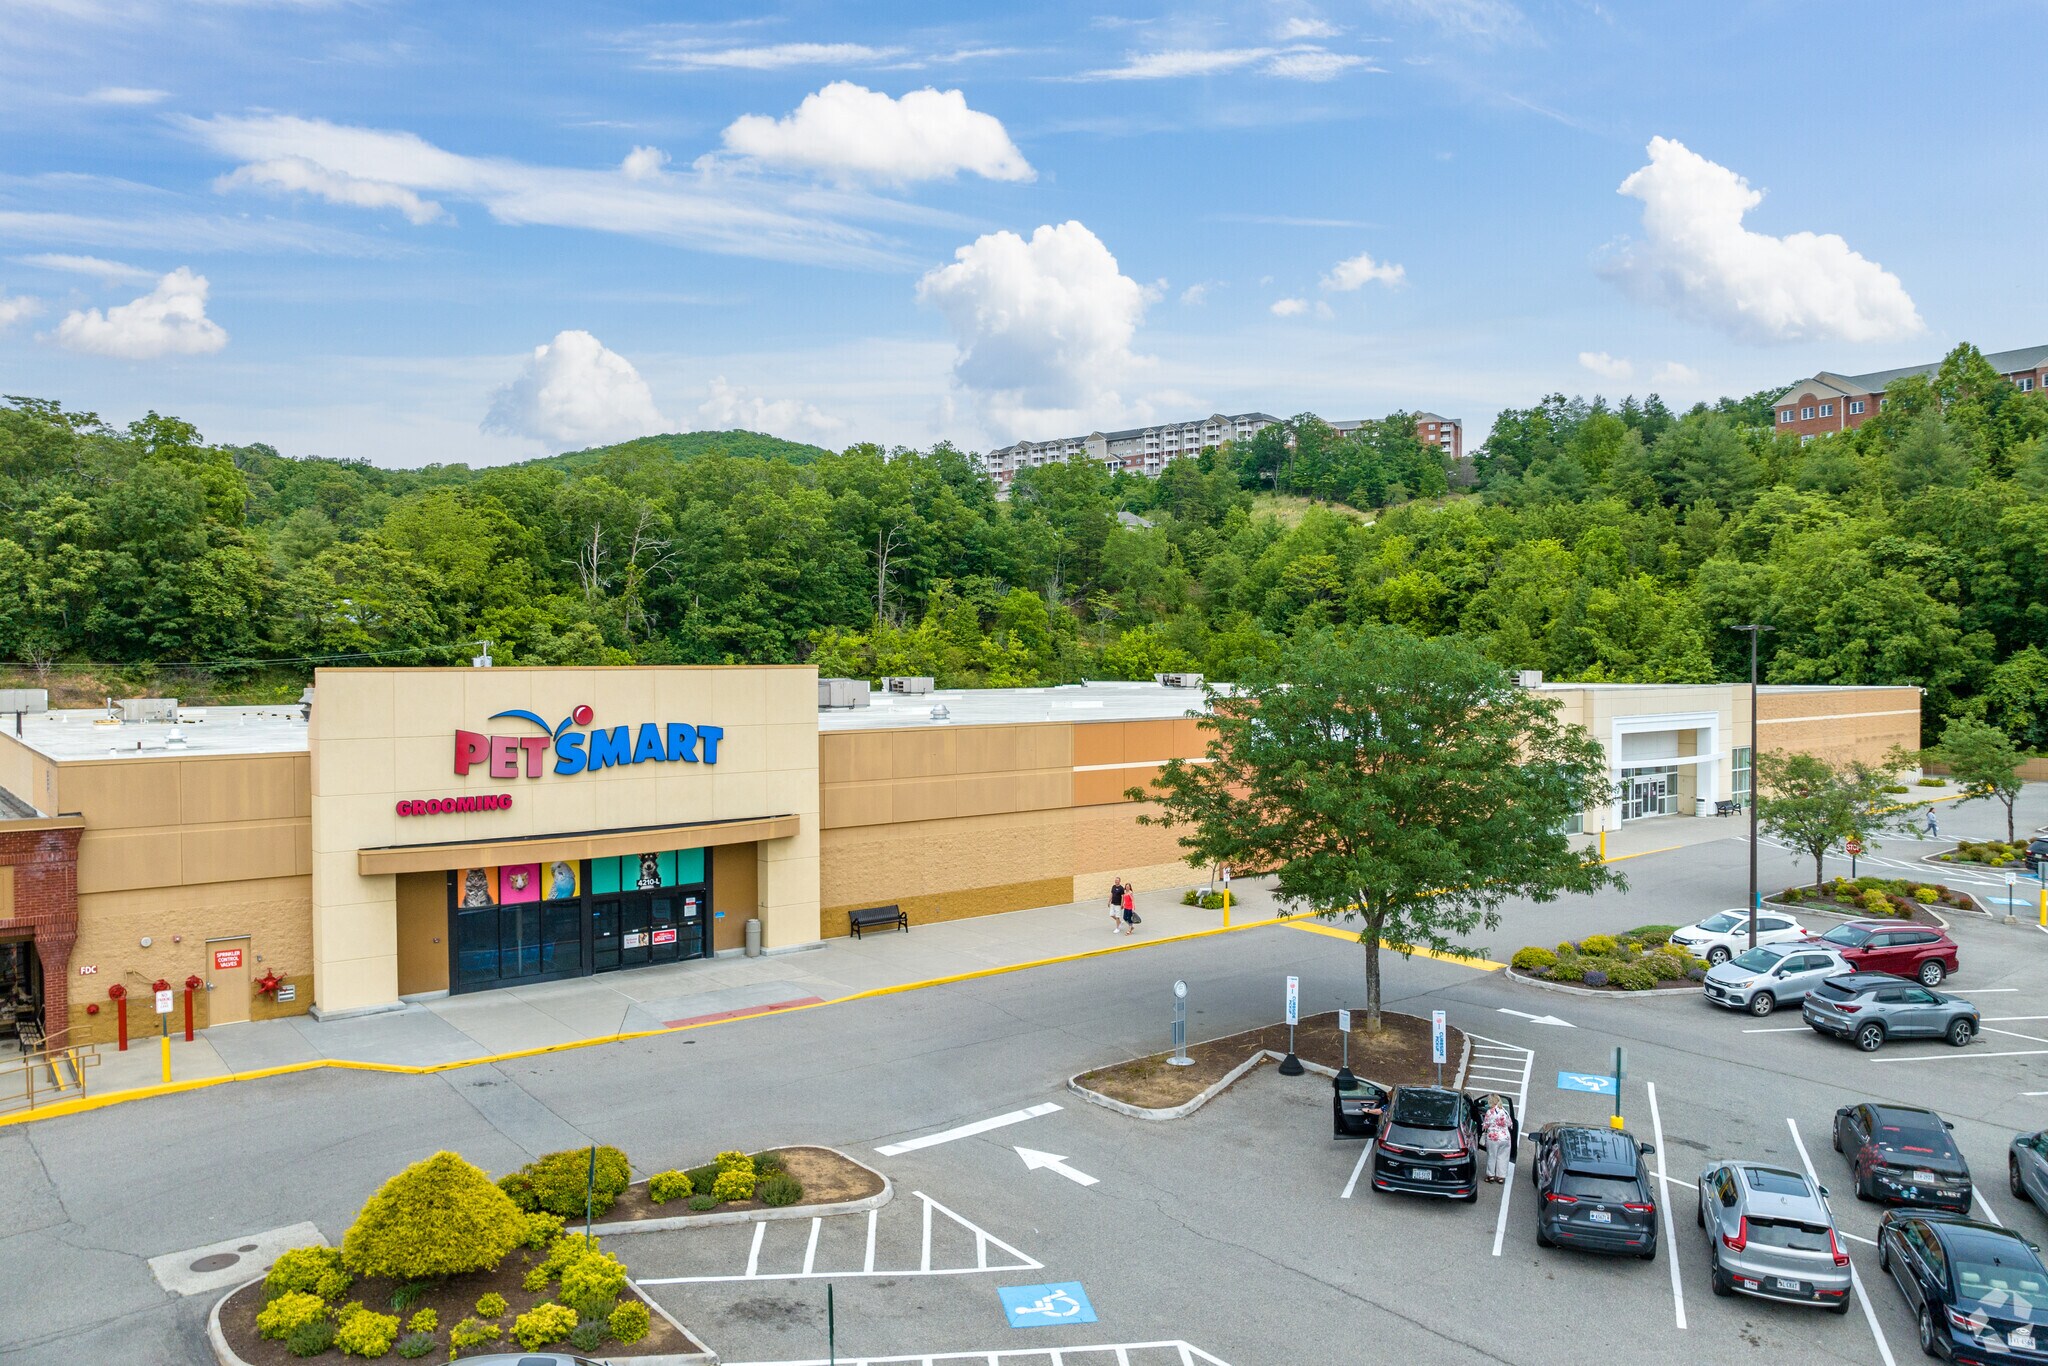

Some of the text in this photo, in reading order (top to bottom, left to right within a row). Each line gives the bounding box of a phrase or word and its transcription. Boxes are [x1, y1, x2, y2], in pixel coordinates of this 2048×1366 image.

[396, 794, 513, 817] GROOMING
[637, 877, 660, 886] 4210-L
[216, 950, 241, 958] SPRINKLER
[80, 965, 97, 975] FDC
